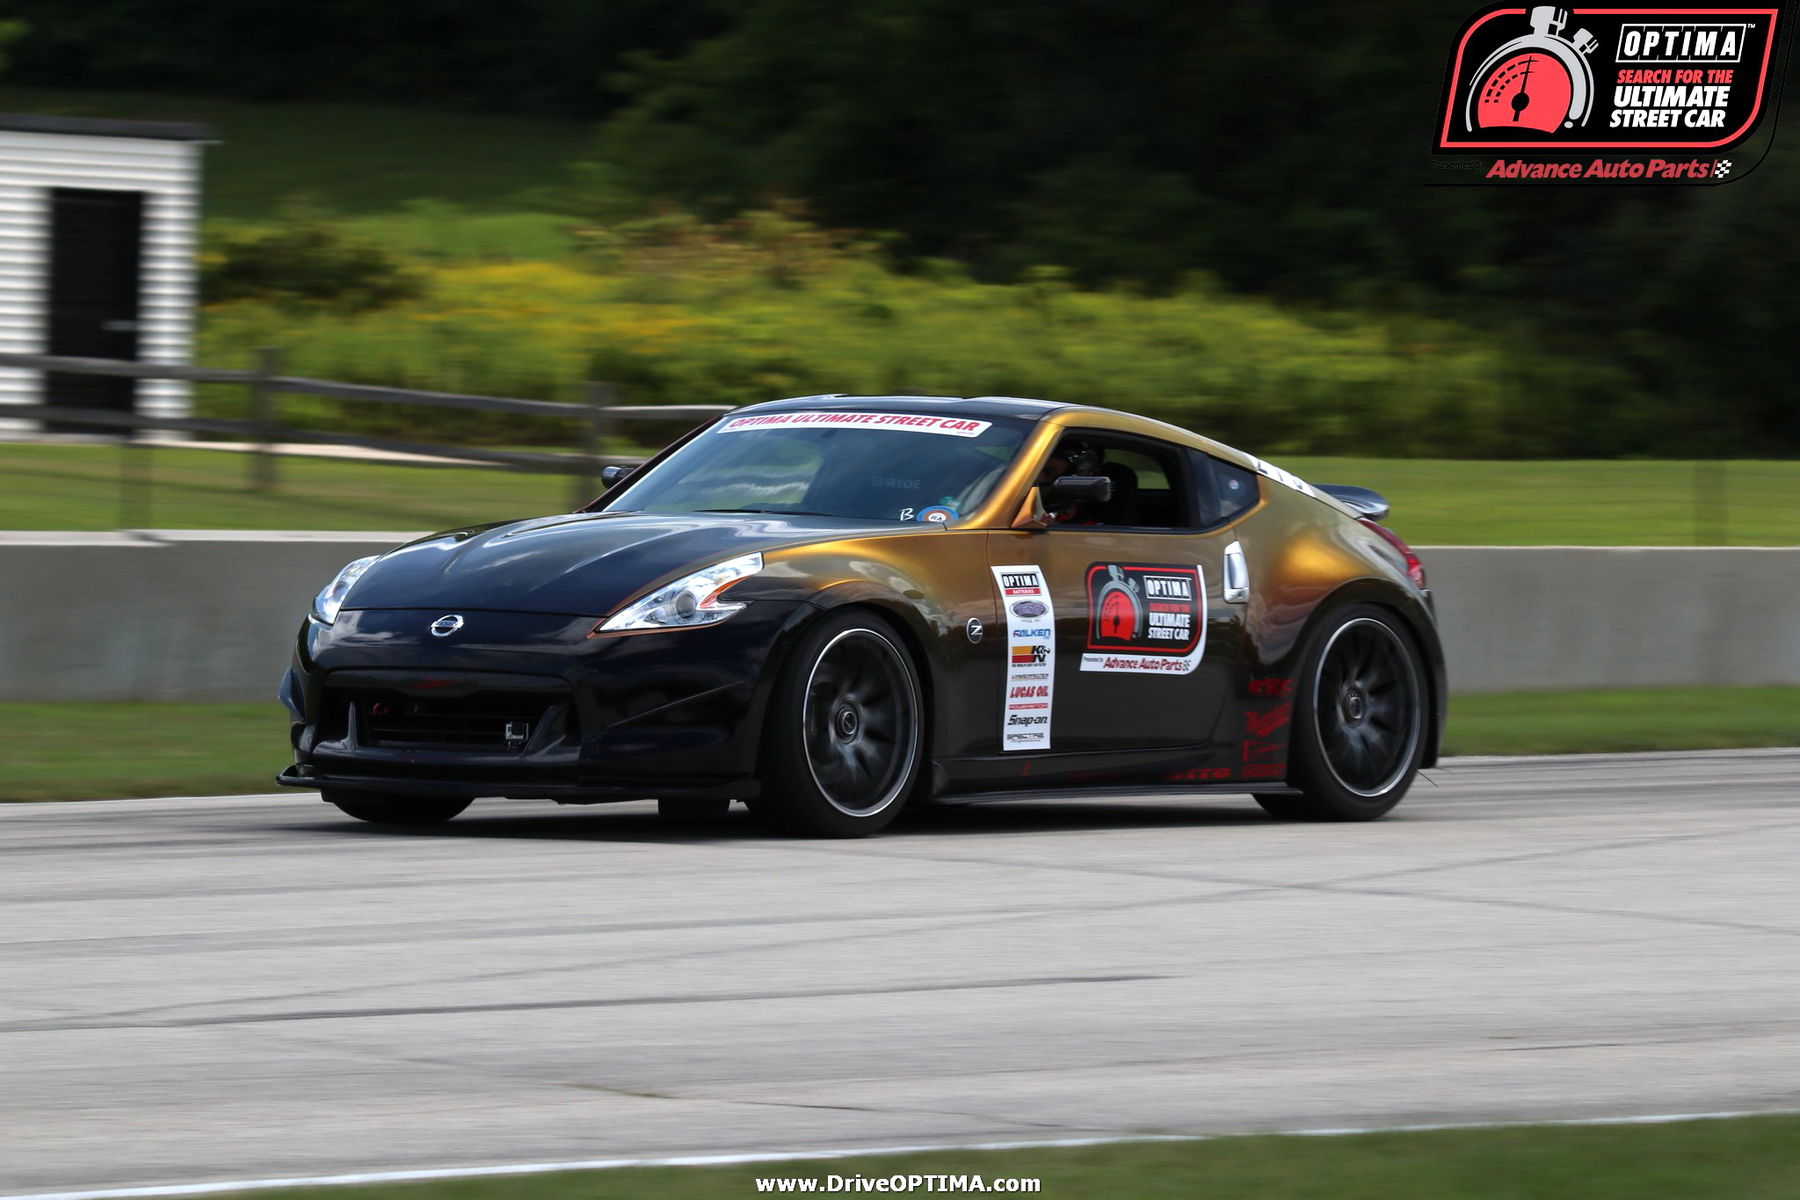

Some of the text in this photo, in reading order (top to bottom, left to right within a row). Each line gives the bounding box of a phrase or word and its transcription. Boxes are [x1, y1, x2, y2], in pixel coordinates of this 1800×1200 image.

[729, 414, 980, 431] OPTIMA ULTIMATE STREET CAR
[1003, 575, 1039, 587] OPTIMA
[1147, 579, 1190, 597] OPTIMA
[1149, 612, 1191, 628] ULTIMATE
[1012, 629, 1051, 637] FALKEN
[1148, 626, 1190, 640] STREET CAR
[1103, 657, 1183, 672] Advance Auto Parts
[1009, 686, 1049, 698] LUCAS OIL
[1008, 714, 1048, 727] Snap-on
